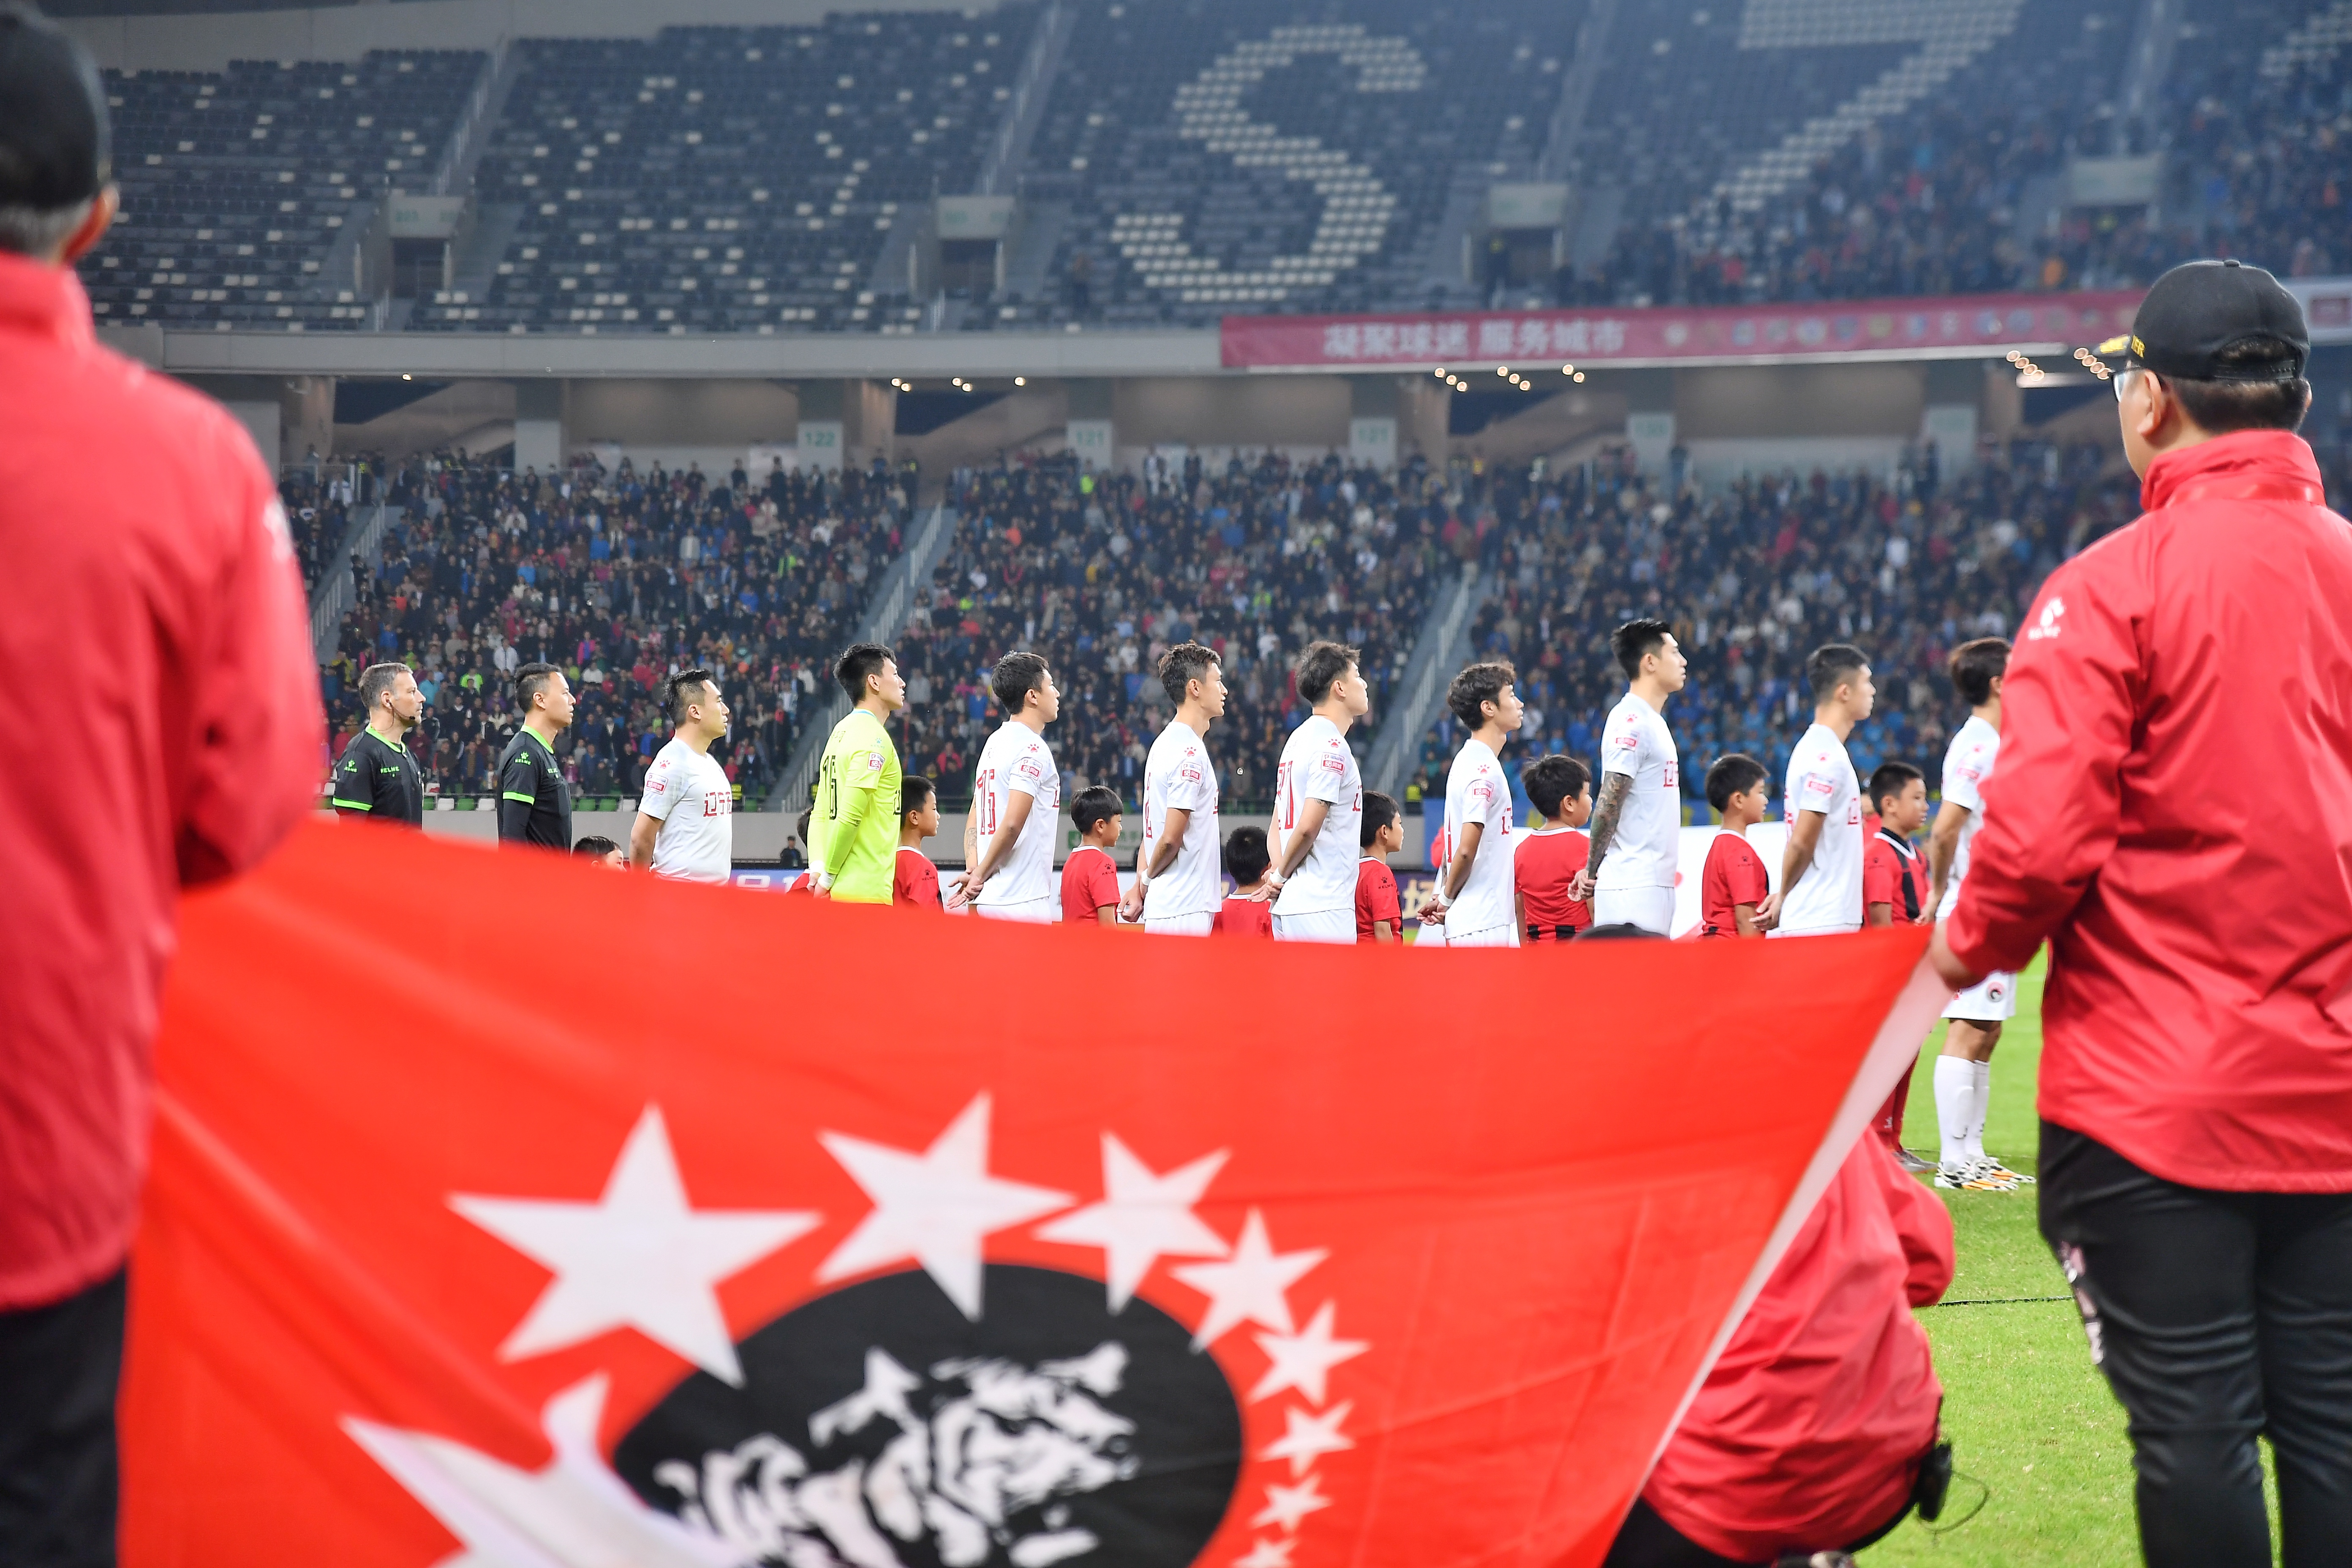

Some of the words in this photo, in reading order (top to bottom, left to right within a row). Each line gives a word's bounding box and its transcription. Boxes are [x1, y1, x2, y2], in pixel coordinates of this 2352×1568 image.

[1480, 318, 1628, 355] 服务城市
[805, 431, 835, 447] 122
[1076, 430, 1104, 446] 121
[380, 766, 400, 774] KELME
[1325, 761, 1342, 770] 58同城
[976, 769, 996, 835] 15
